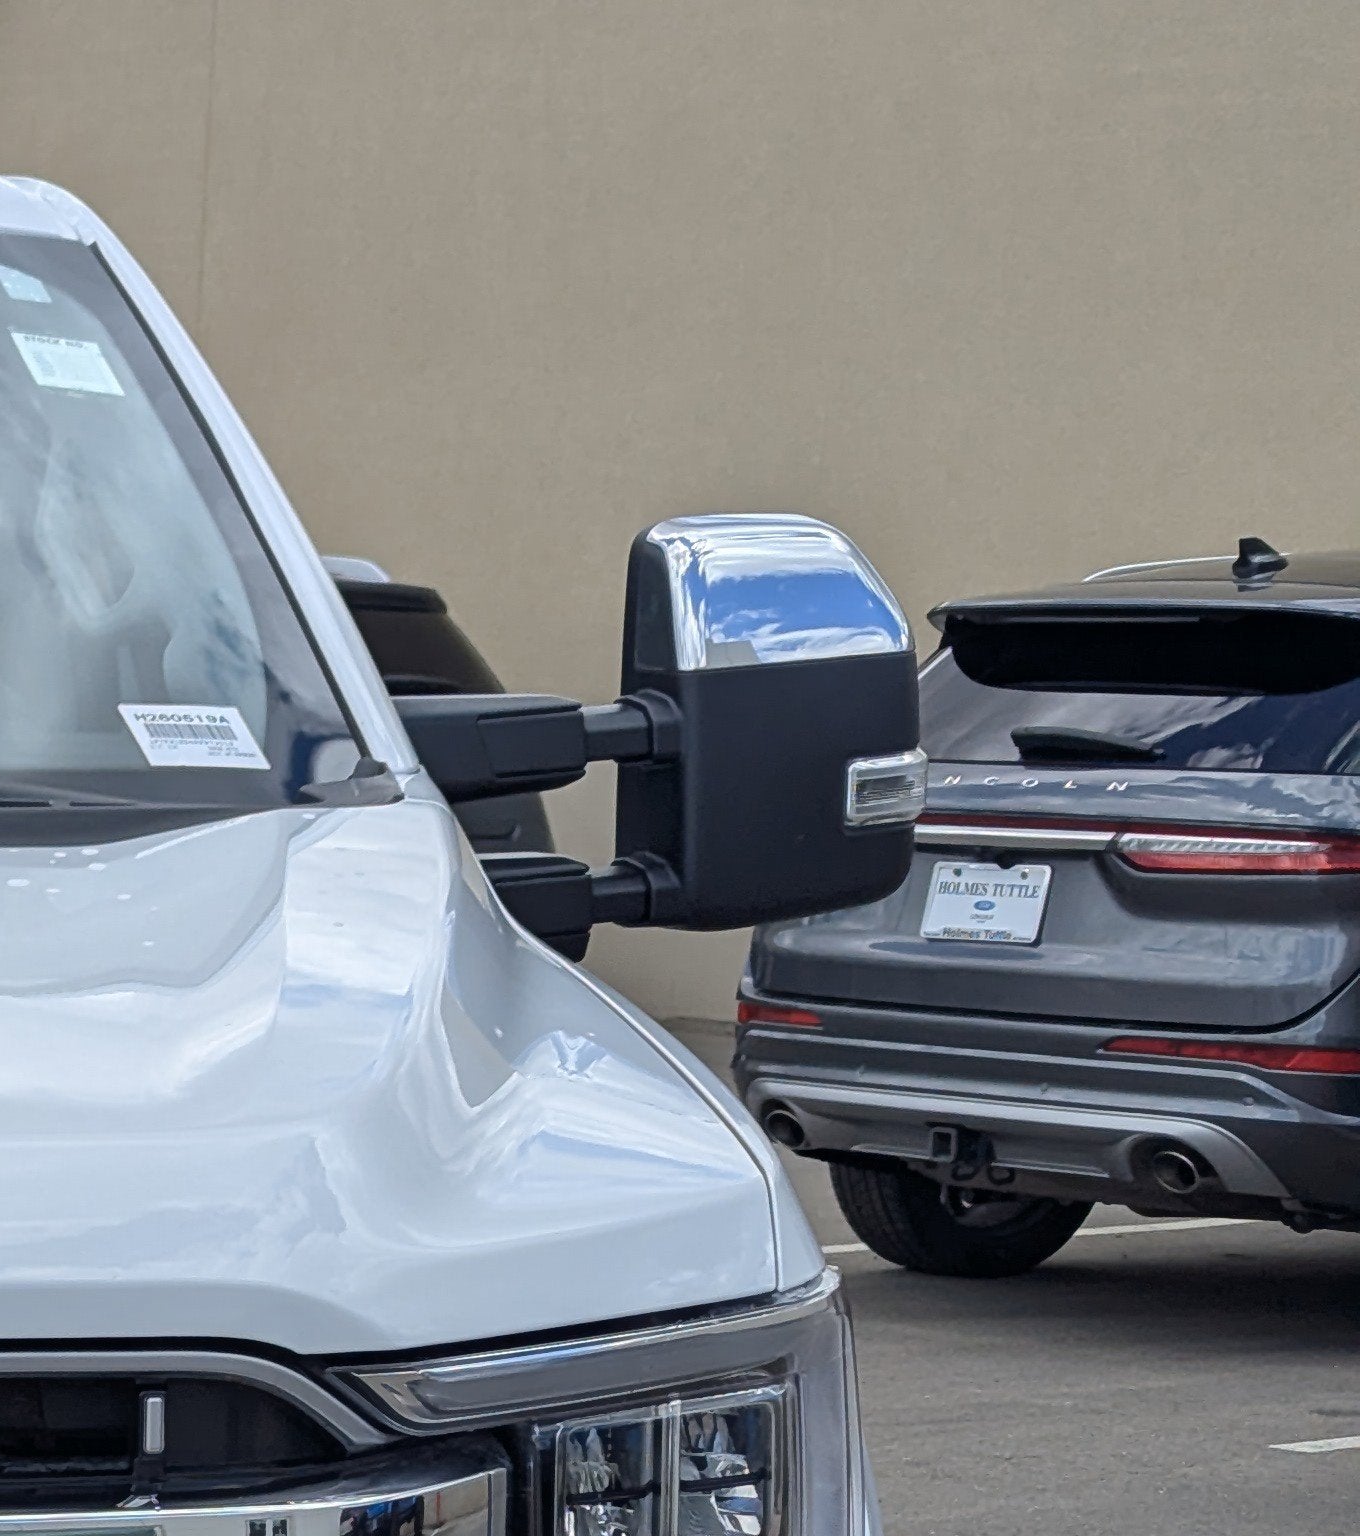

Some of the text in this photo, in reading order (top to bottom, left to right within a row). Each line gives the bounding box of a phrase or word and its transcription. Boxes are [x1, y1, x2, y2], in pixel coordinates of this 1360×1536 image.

[944, 775, 1129, 791] NCOLN
[938, 881, 1040, 898] HOLMES TUTTLE
[942, 927, 980, 939] Holmes
[984, 929, 1012, 940] Tuttle
